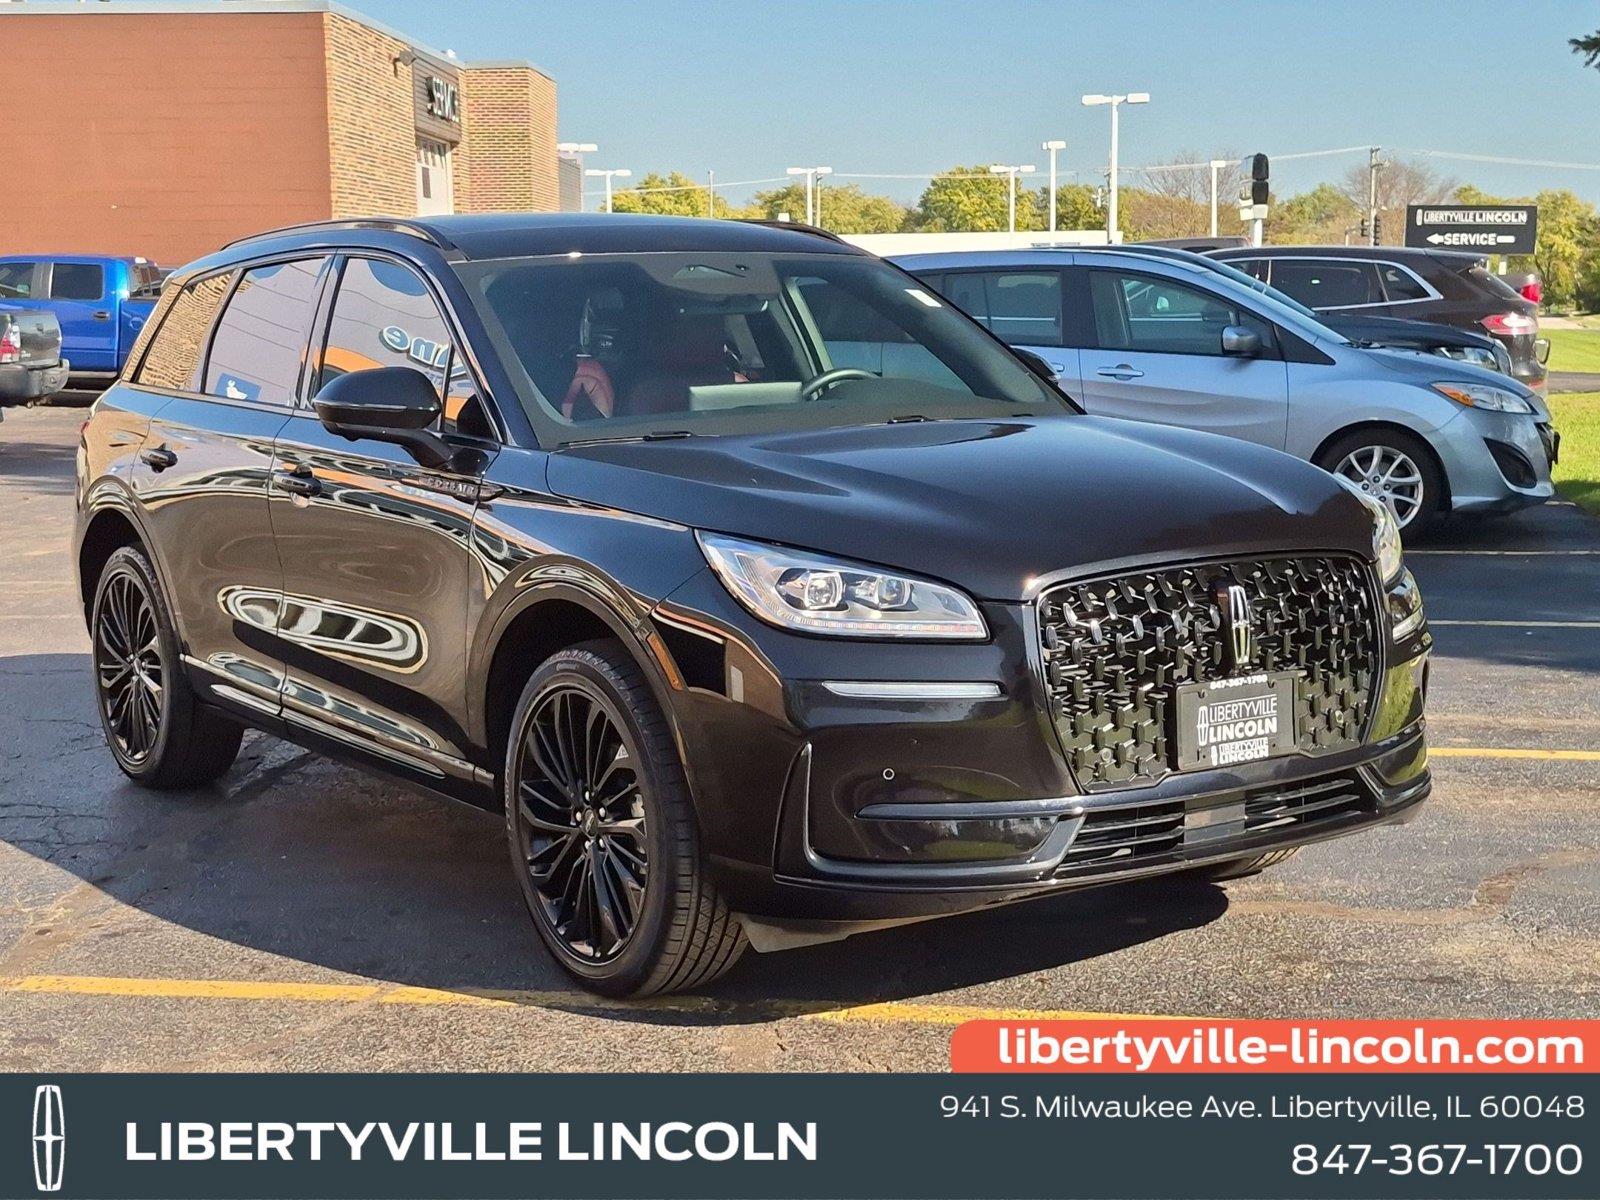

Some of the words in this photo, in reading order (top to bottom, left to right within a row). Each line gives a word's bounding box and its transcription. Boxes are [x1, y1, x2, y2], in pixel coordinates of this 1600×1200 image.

[1423, 211, 1474, 223] LIBERTYVILLE
[1475, 210, 1527, 223] LINCOLN
[1443, 233, 1497, 245] SERVICE
[1209, 697, 1278, 723] LIBERTYVILLE
[1209, 717, 1278, 743] LINCOLN
[1219, 738, 1268, 754] LIBERTYVILLE
[1220, 747, 1269, 765] LINCOLN
